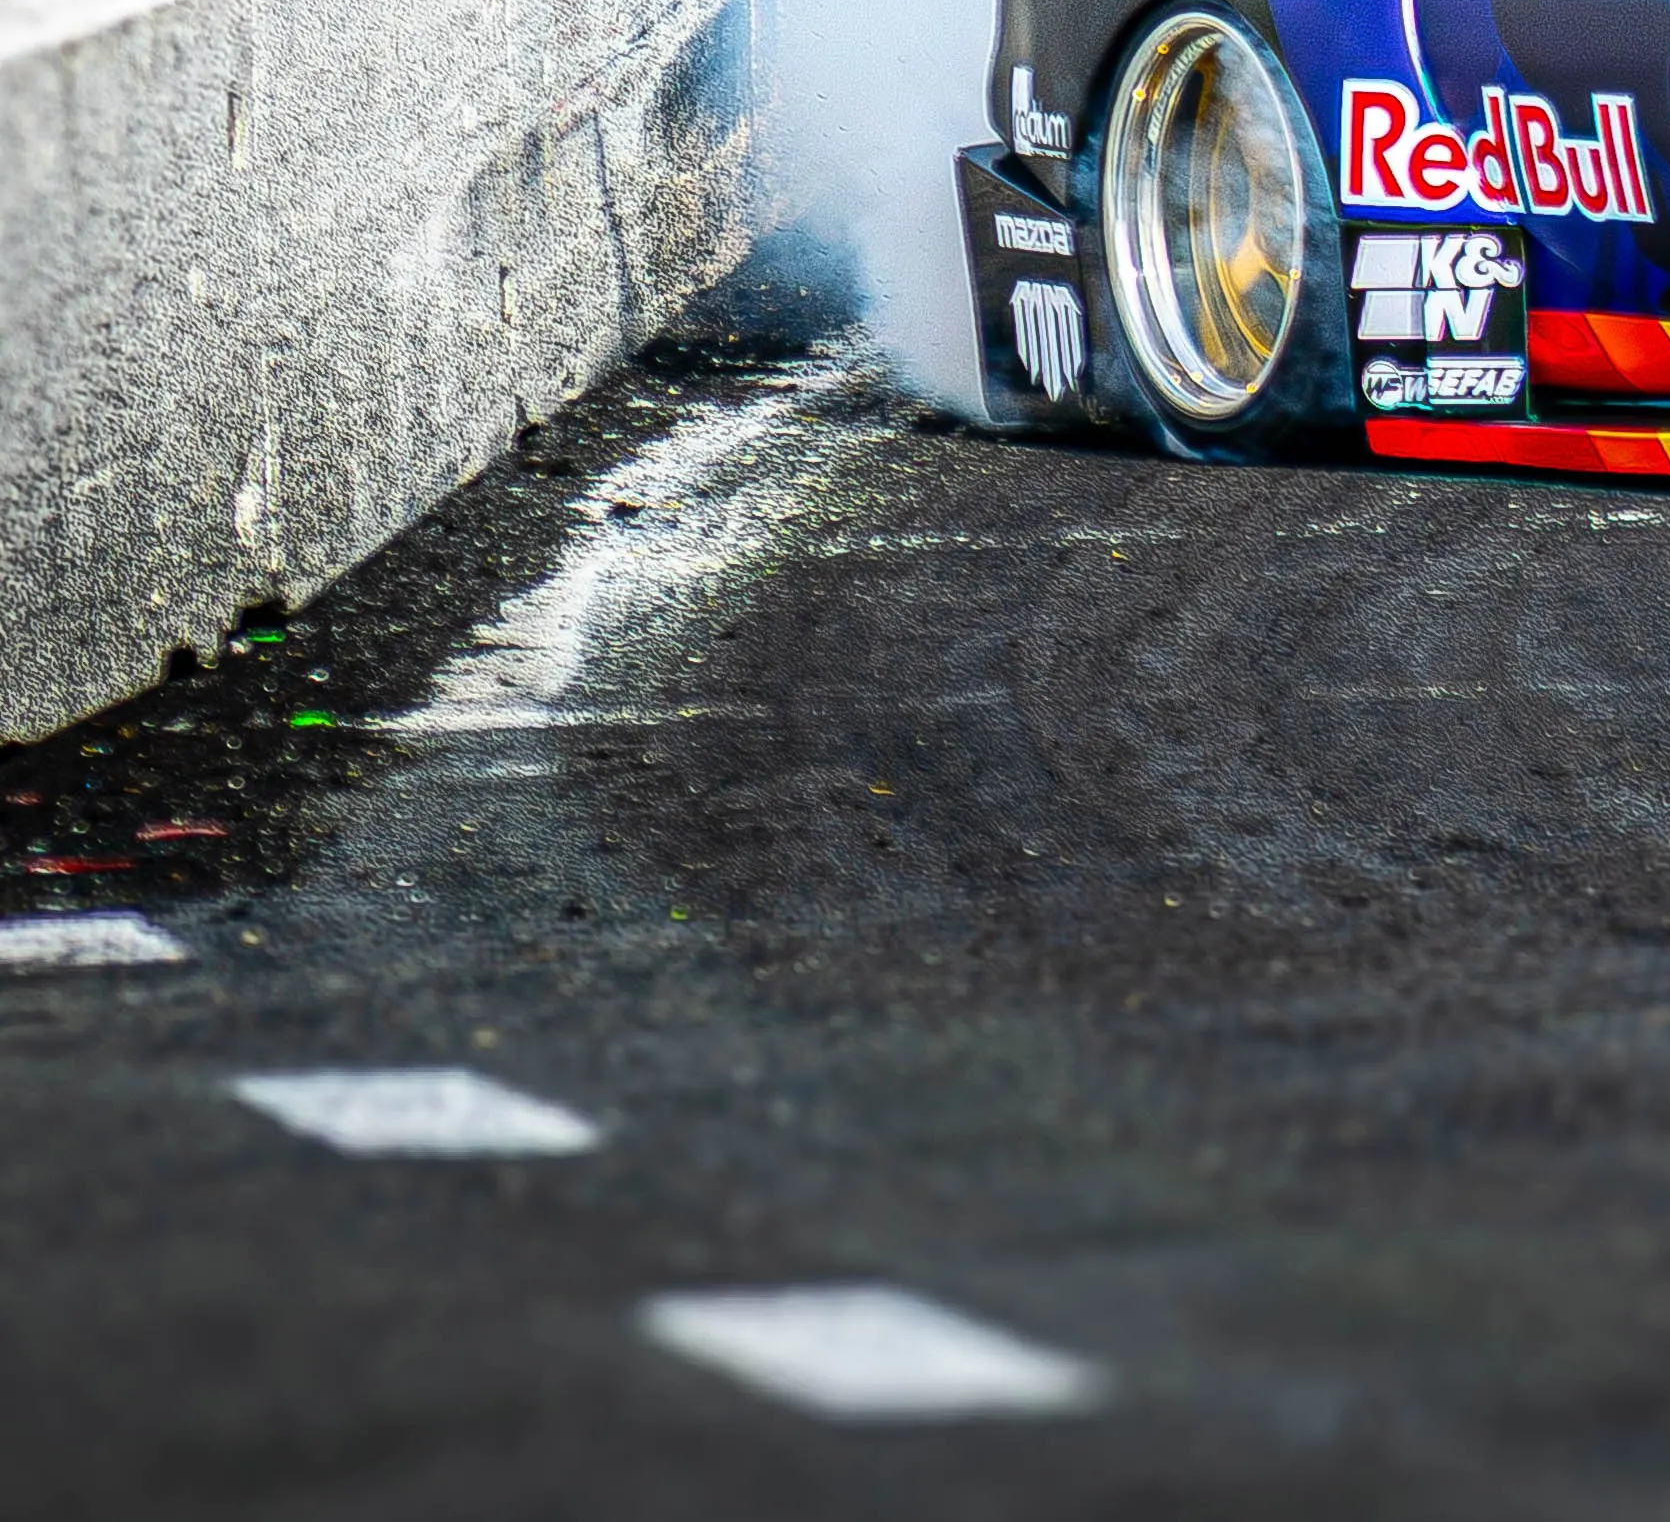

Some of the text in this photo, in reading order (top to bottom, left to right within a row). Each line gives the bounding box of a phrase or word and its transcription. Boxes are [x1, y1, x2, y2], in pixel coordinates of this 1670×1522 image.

[1341, 79, 1518, 212] Red
[1511, 91, 1656, 222] Bull
[995, 213, 1075, 256] mazda
